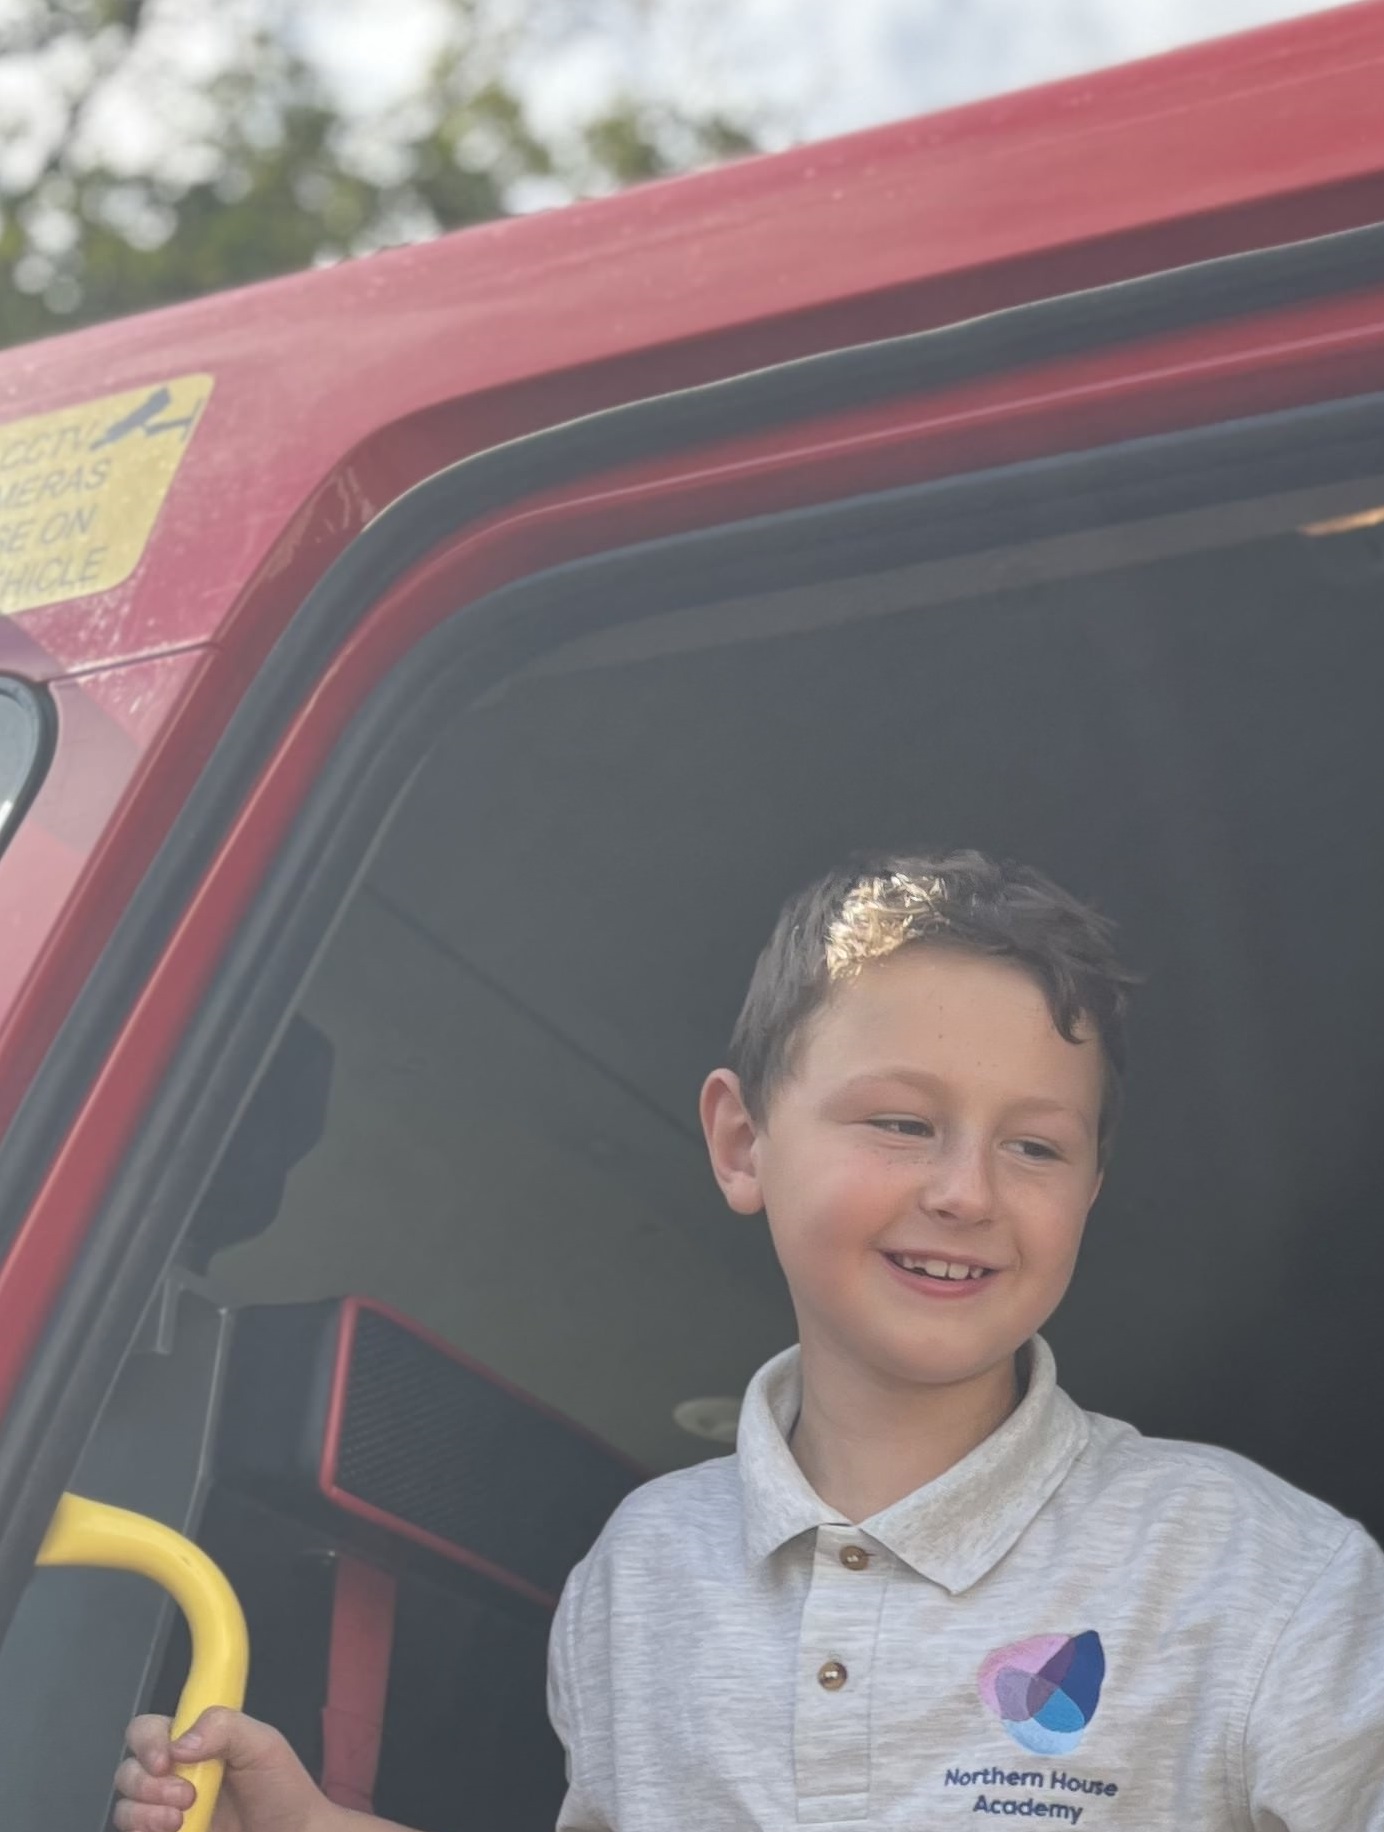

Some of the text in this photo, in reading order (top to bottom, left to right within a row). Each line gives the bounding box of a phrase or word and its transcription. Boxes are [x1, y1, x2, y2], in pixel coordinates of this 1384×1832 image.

[41, 503, 99, 546] ON
[0, 545, 109, 599] HICLE
[944, 1766, 1119, 1797] Northern House
[972, 1794, 1083, 1825] Academy
